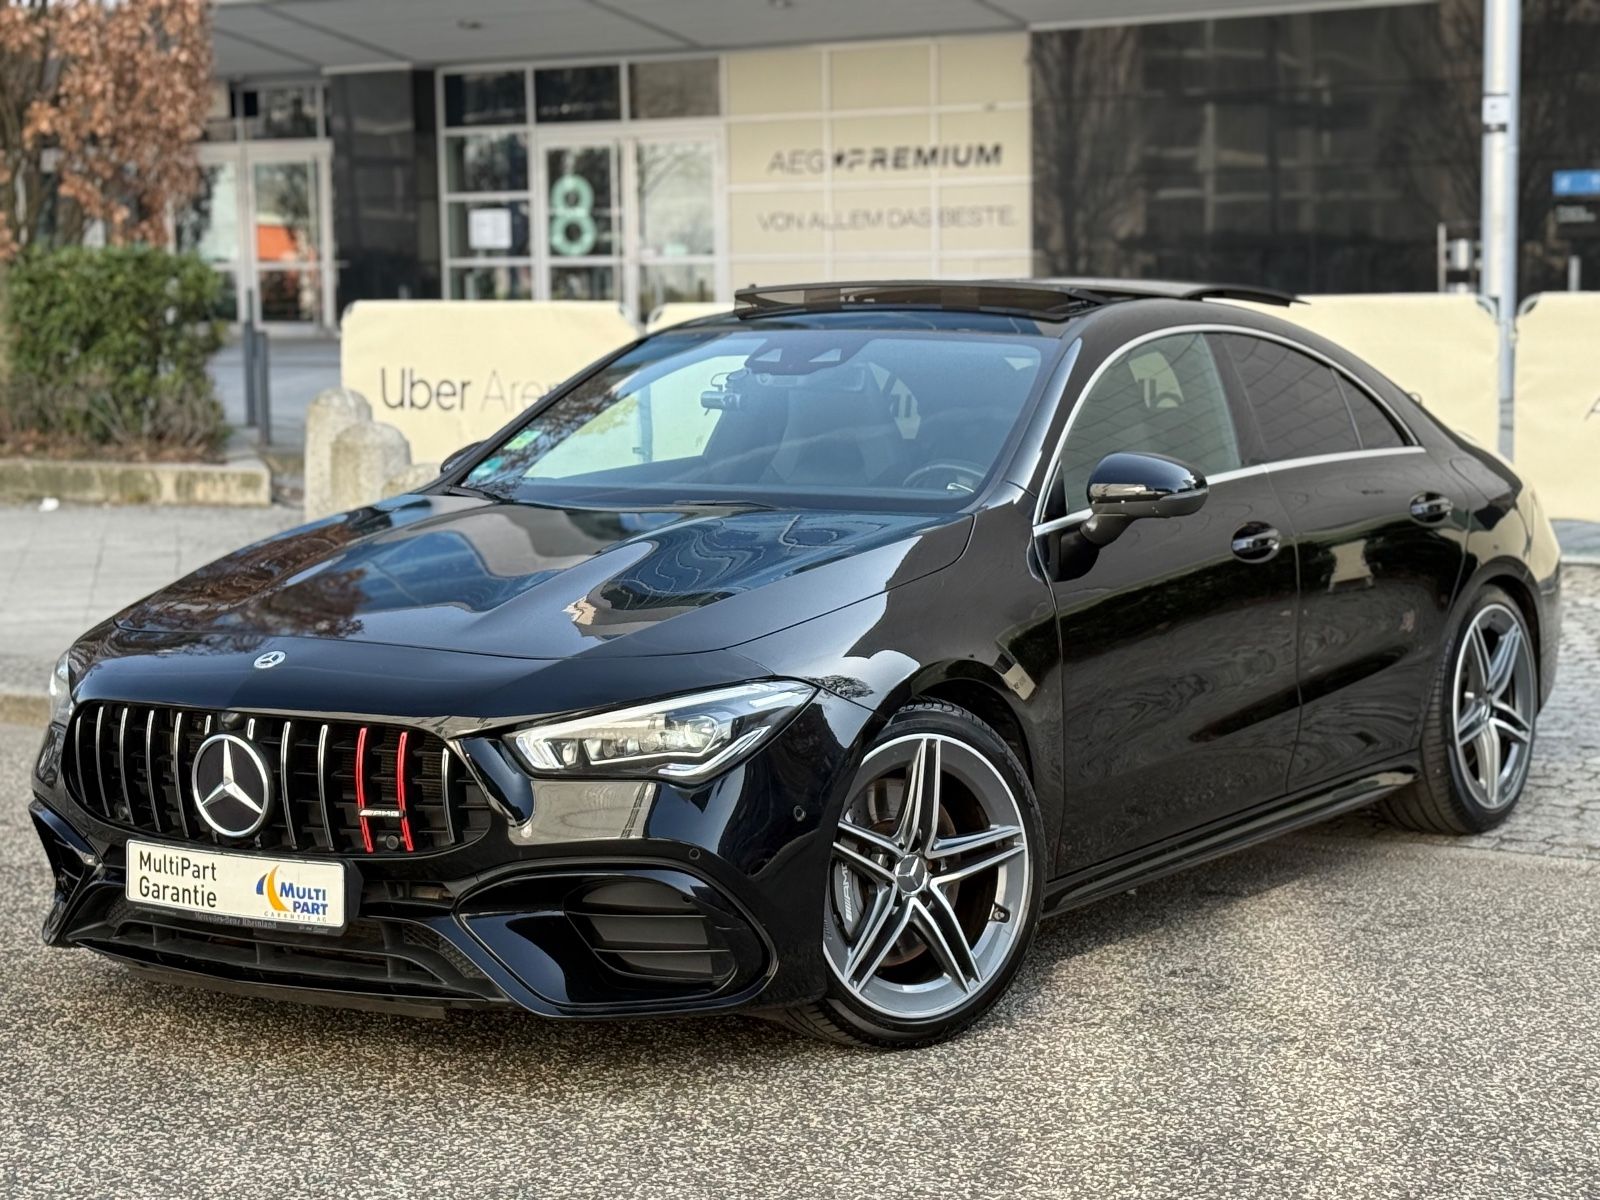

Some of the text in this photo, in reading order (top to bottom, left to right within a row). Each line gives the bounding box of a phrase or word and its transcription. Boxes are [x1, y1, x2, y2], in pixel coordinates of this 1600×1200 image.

[768, 144, 1002, 174] AEG PREMIUM
[757, 211, 804, 232] VON
[807, 208, 882, 231] ALLEM
[887, 207, 932, 229] DAS
[380, 367, 560, 413] Uber Are
[139, 850, 217, 881] MultiPart
[139, 875, 217, 908] Garantie
[293, 901, 329, 915] PART
